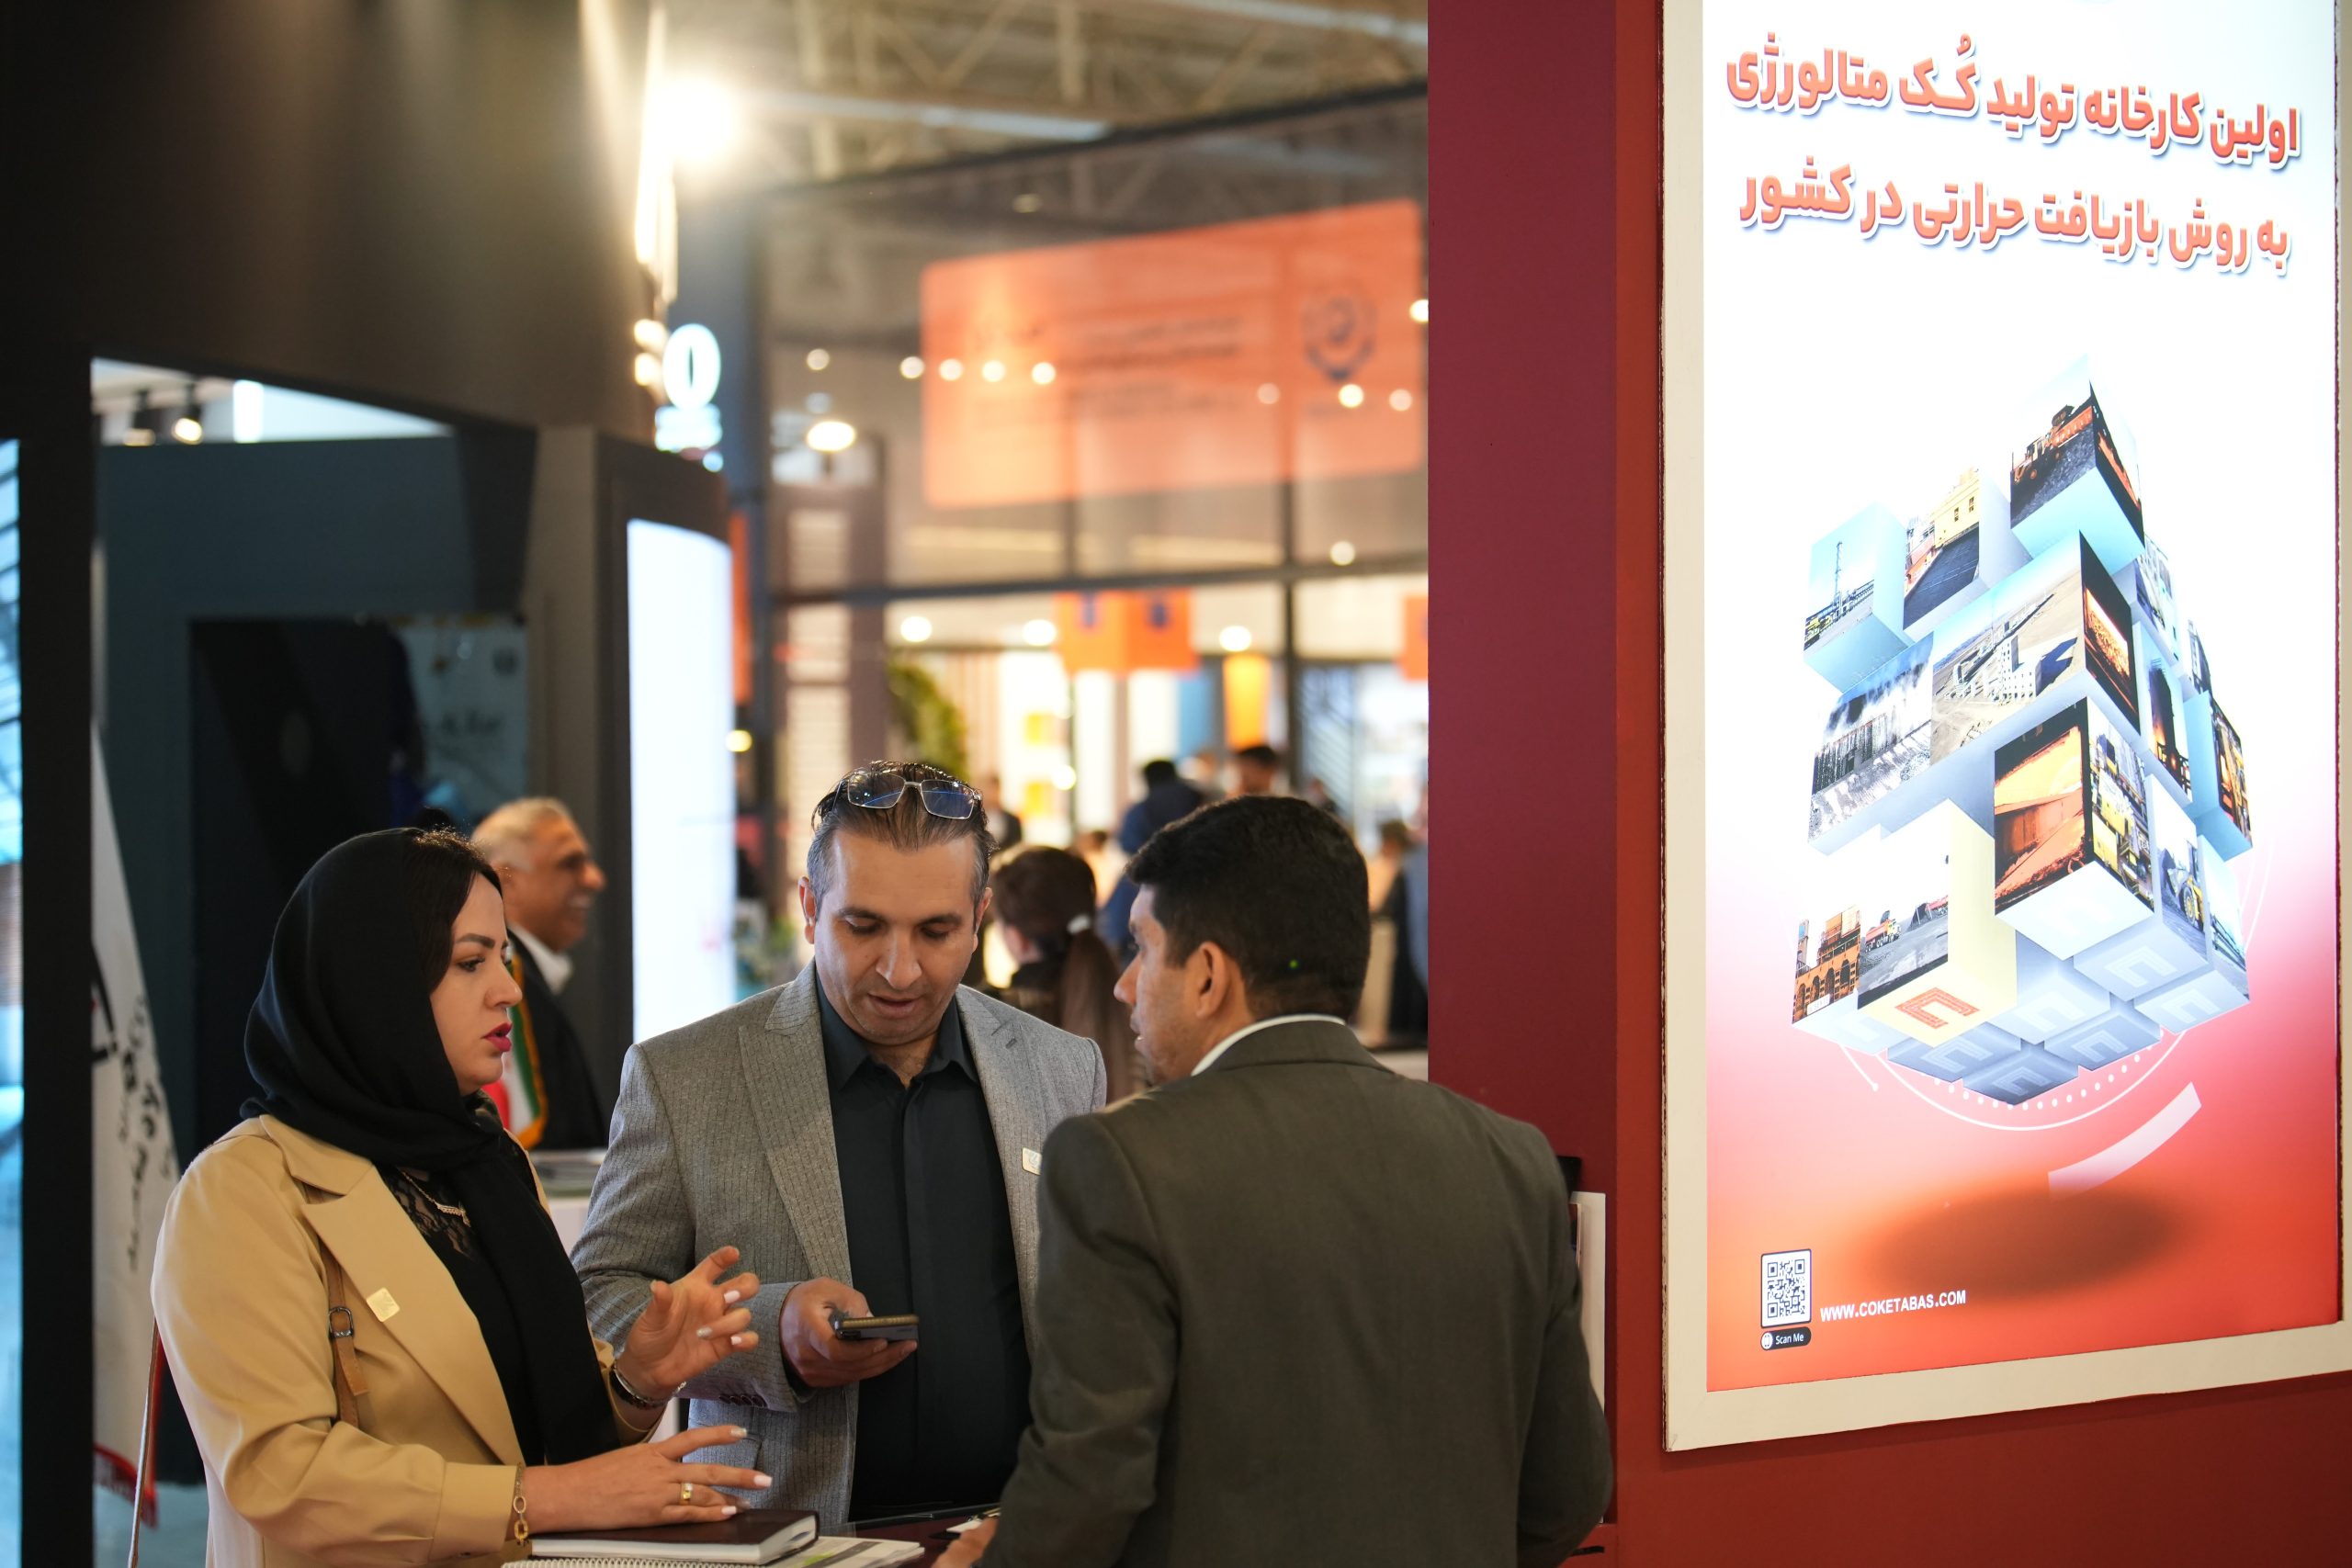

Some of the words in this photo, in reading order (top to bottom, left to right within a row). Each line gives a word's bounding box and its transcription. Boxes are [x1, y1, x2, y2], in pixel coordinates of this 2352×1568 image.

[1726, 31, 1889, 109] متالورژی
[1986, 73, 2075, 138] تولید
[2084, 85, 2200, 150] کارخانه
[2210, 103, 2297, 164] اولین
[1739, 154, 1851, 224] کشور
[1860, 180, 1903, 233] در
[1913, 181, 2025, 244] حرارتی
[2034, 189, 2159, 258] بازیافت
[2168, 197, 2247, 267] روش
[2256, 219, 2288, 270] به
[1819, 1290, 1967, 1323] WWW.COKETABAS.COM
[1775, 1335, 1792, 1346] Scan
[1792, 1332, 1804, 1343] Me
